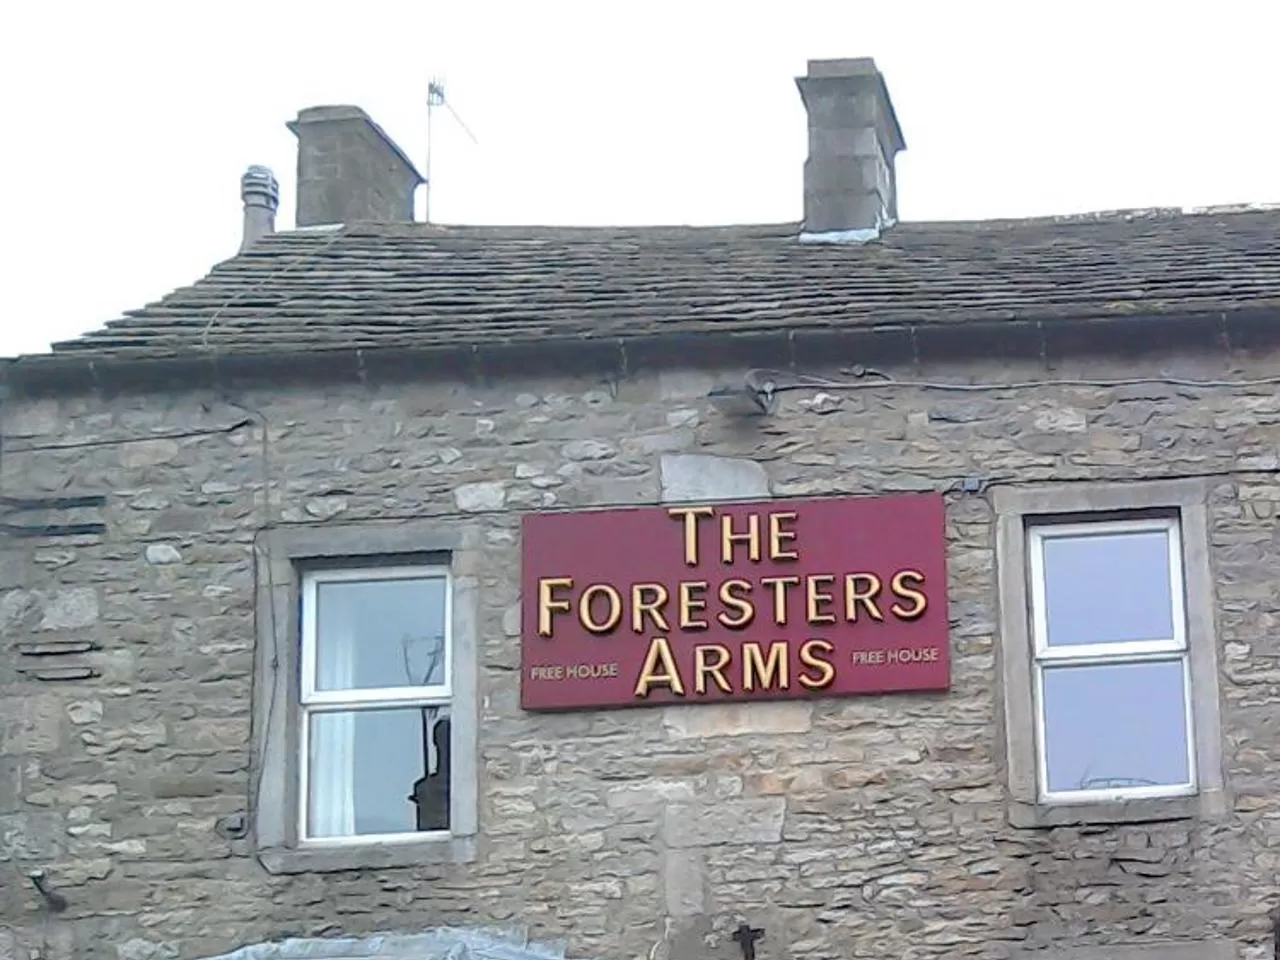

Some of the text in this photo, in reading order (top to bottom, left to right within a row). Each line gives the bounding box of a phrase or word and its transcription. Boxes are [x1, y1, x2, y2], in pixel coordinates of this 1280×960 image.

[668, 506, 799, 567] THE
[537, 569, 928, 638] FORESTERS
[531, 661, 619, 680] FREE HOUSE
[634, 636, 835, 698] ARMS
[852, 647, 939, 664] FREE HOUSE
